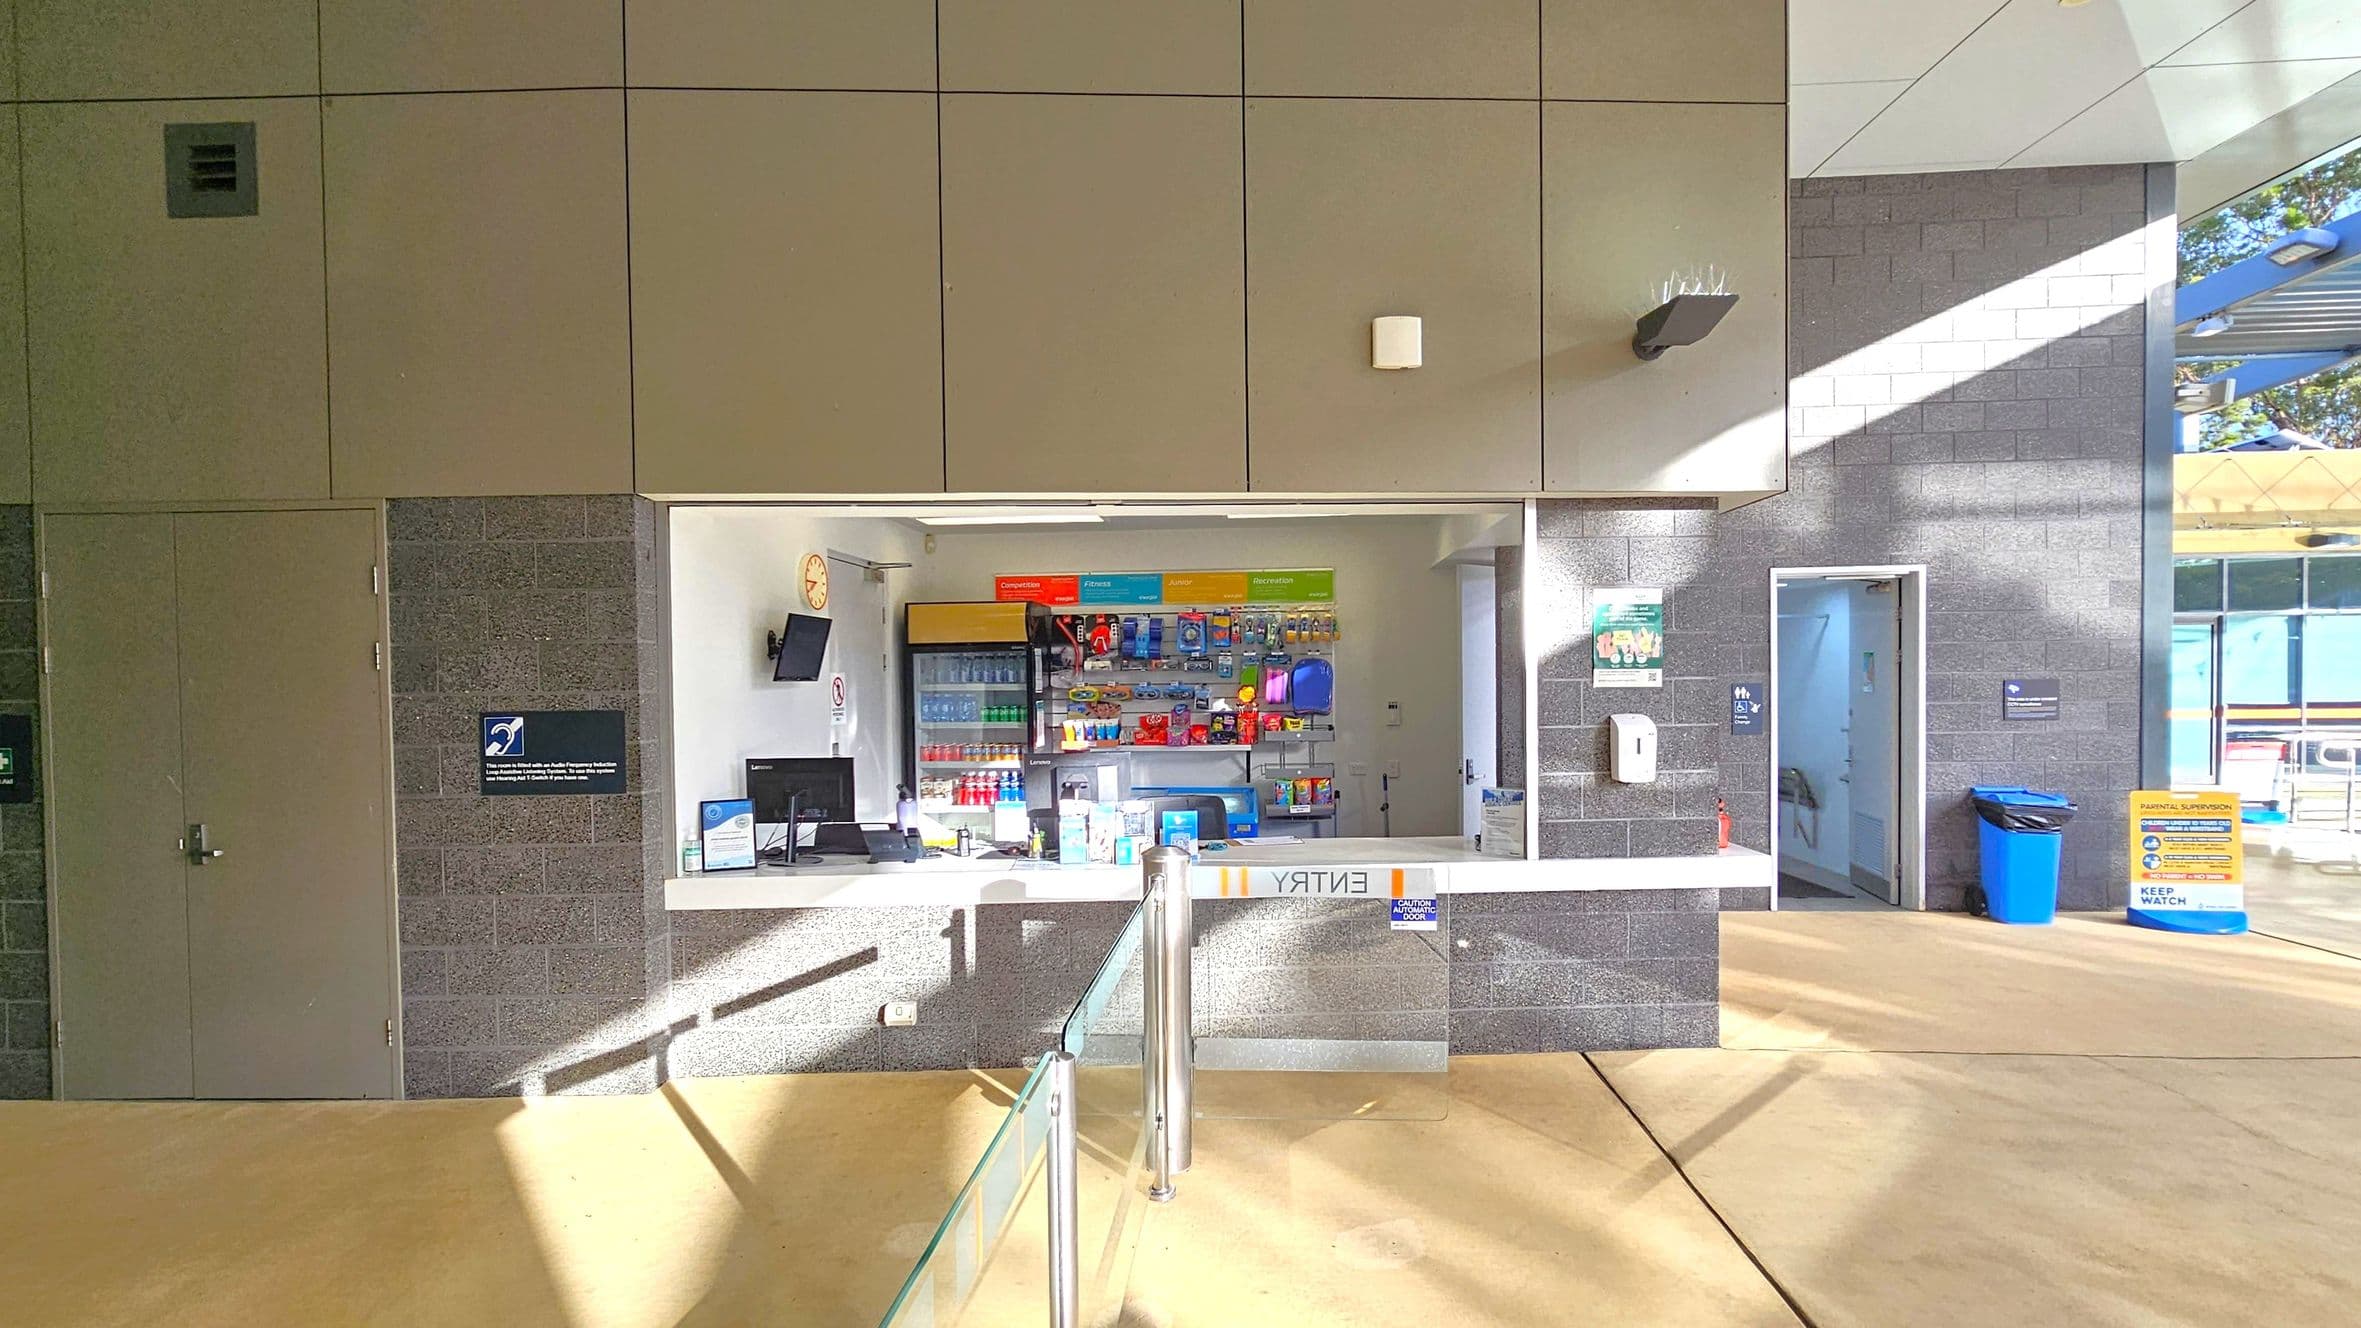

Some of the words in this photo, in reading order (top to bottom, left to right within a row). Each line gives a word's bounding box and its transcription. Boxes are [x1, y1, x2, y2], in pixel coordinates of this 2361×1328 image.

[1000, 581, 1041, 589] Competition
[1168, 578, 1193, 586] Junior
[1253, 577, 1294, 585] Recreation
[2140, 887, 2174, 895] KEEP
[2140, 896, 2186, 905] WATCH
[1393, 906, 1436, 914] AUTOMATIC
